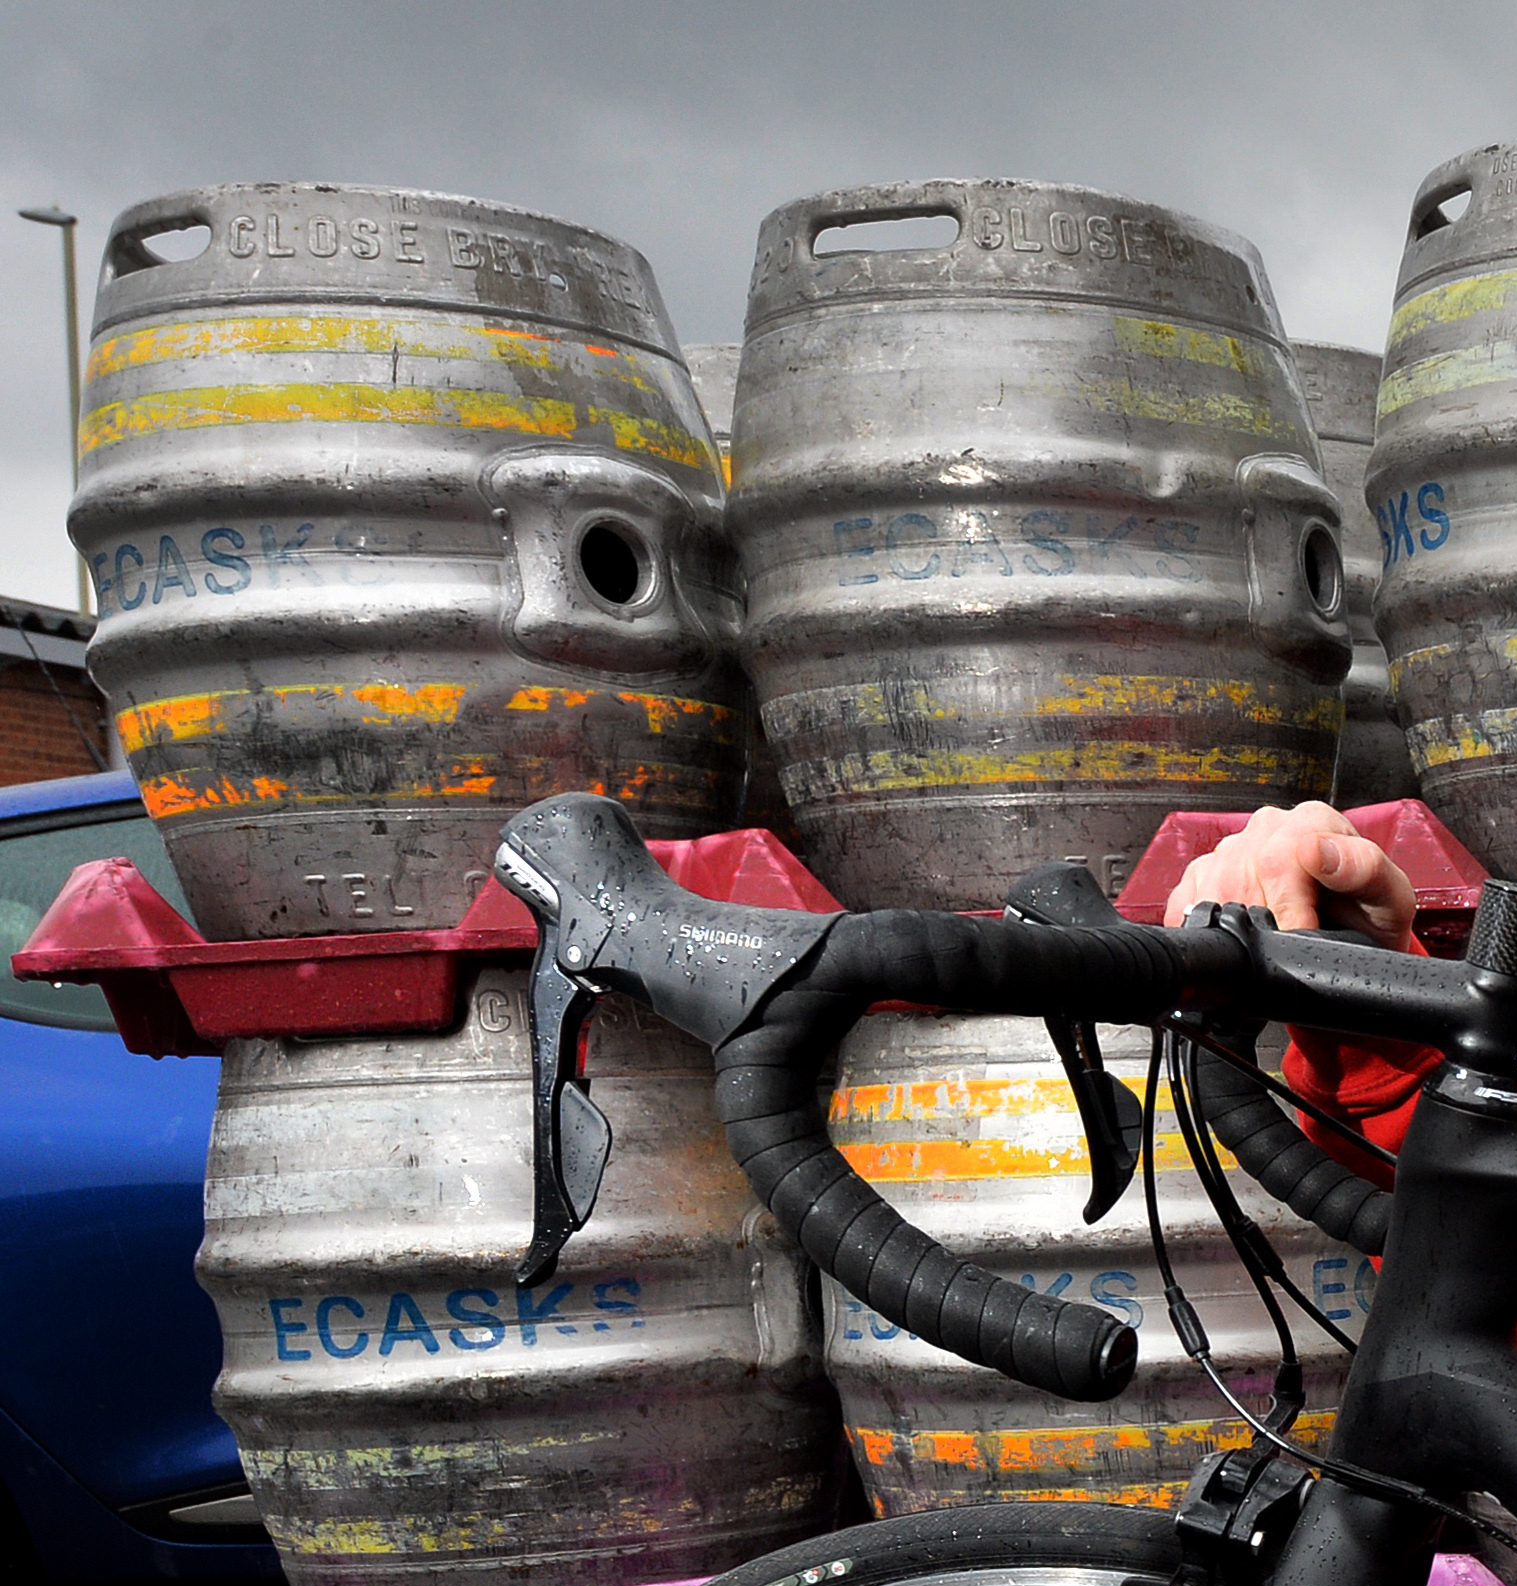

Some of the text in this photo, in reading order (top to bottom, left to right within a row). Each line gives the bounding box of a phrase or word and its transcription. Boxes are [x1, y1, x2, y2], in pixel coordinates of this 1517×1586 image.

[1492, 154, 1517, 175] USE
[229, 213, 424, 265] CLOSE
[971, 207, 1154, 269] CLOSE
[834, 511, 1202, 588] ECASKS
[678, 923, 763, 950] SHIMANO
[269, 1277, 646, 1362] ECASKS
